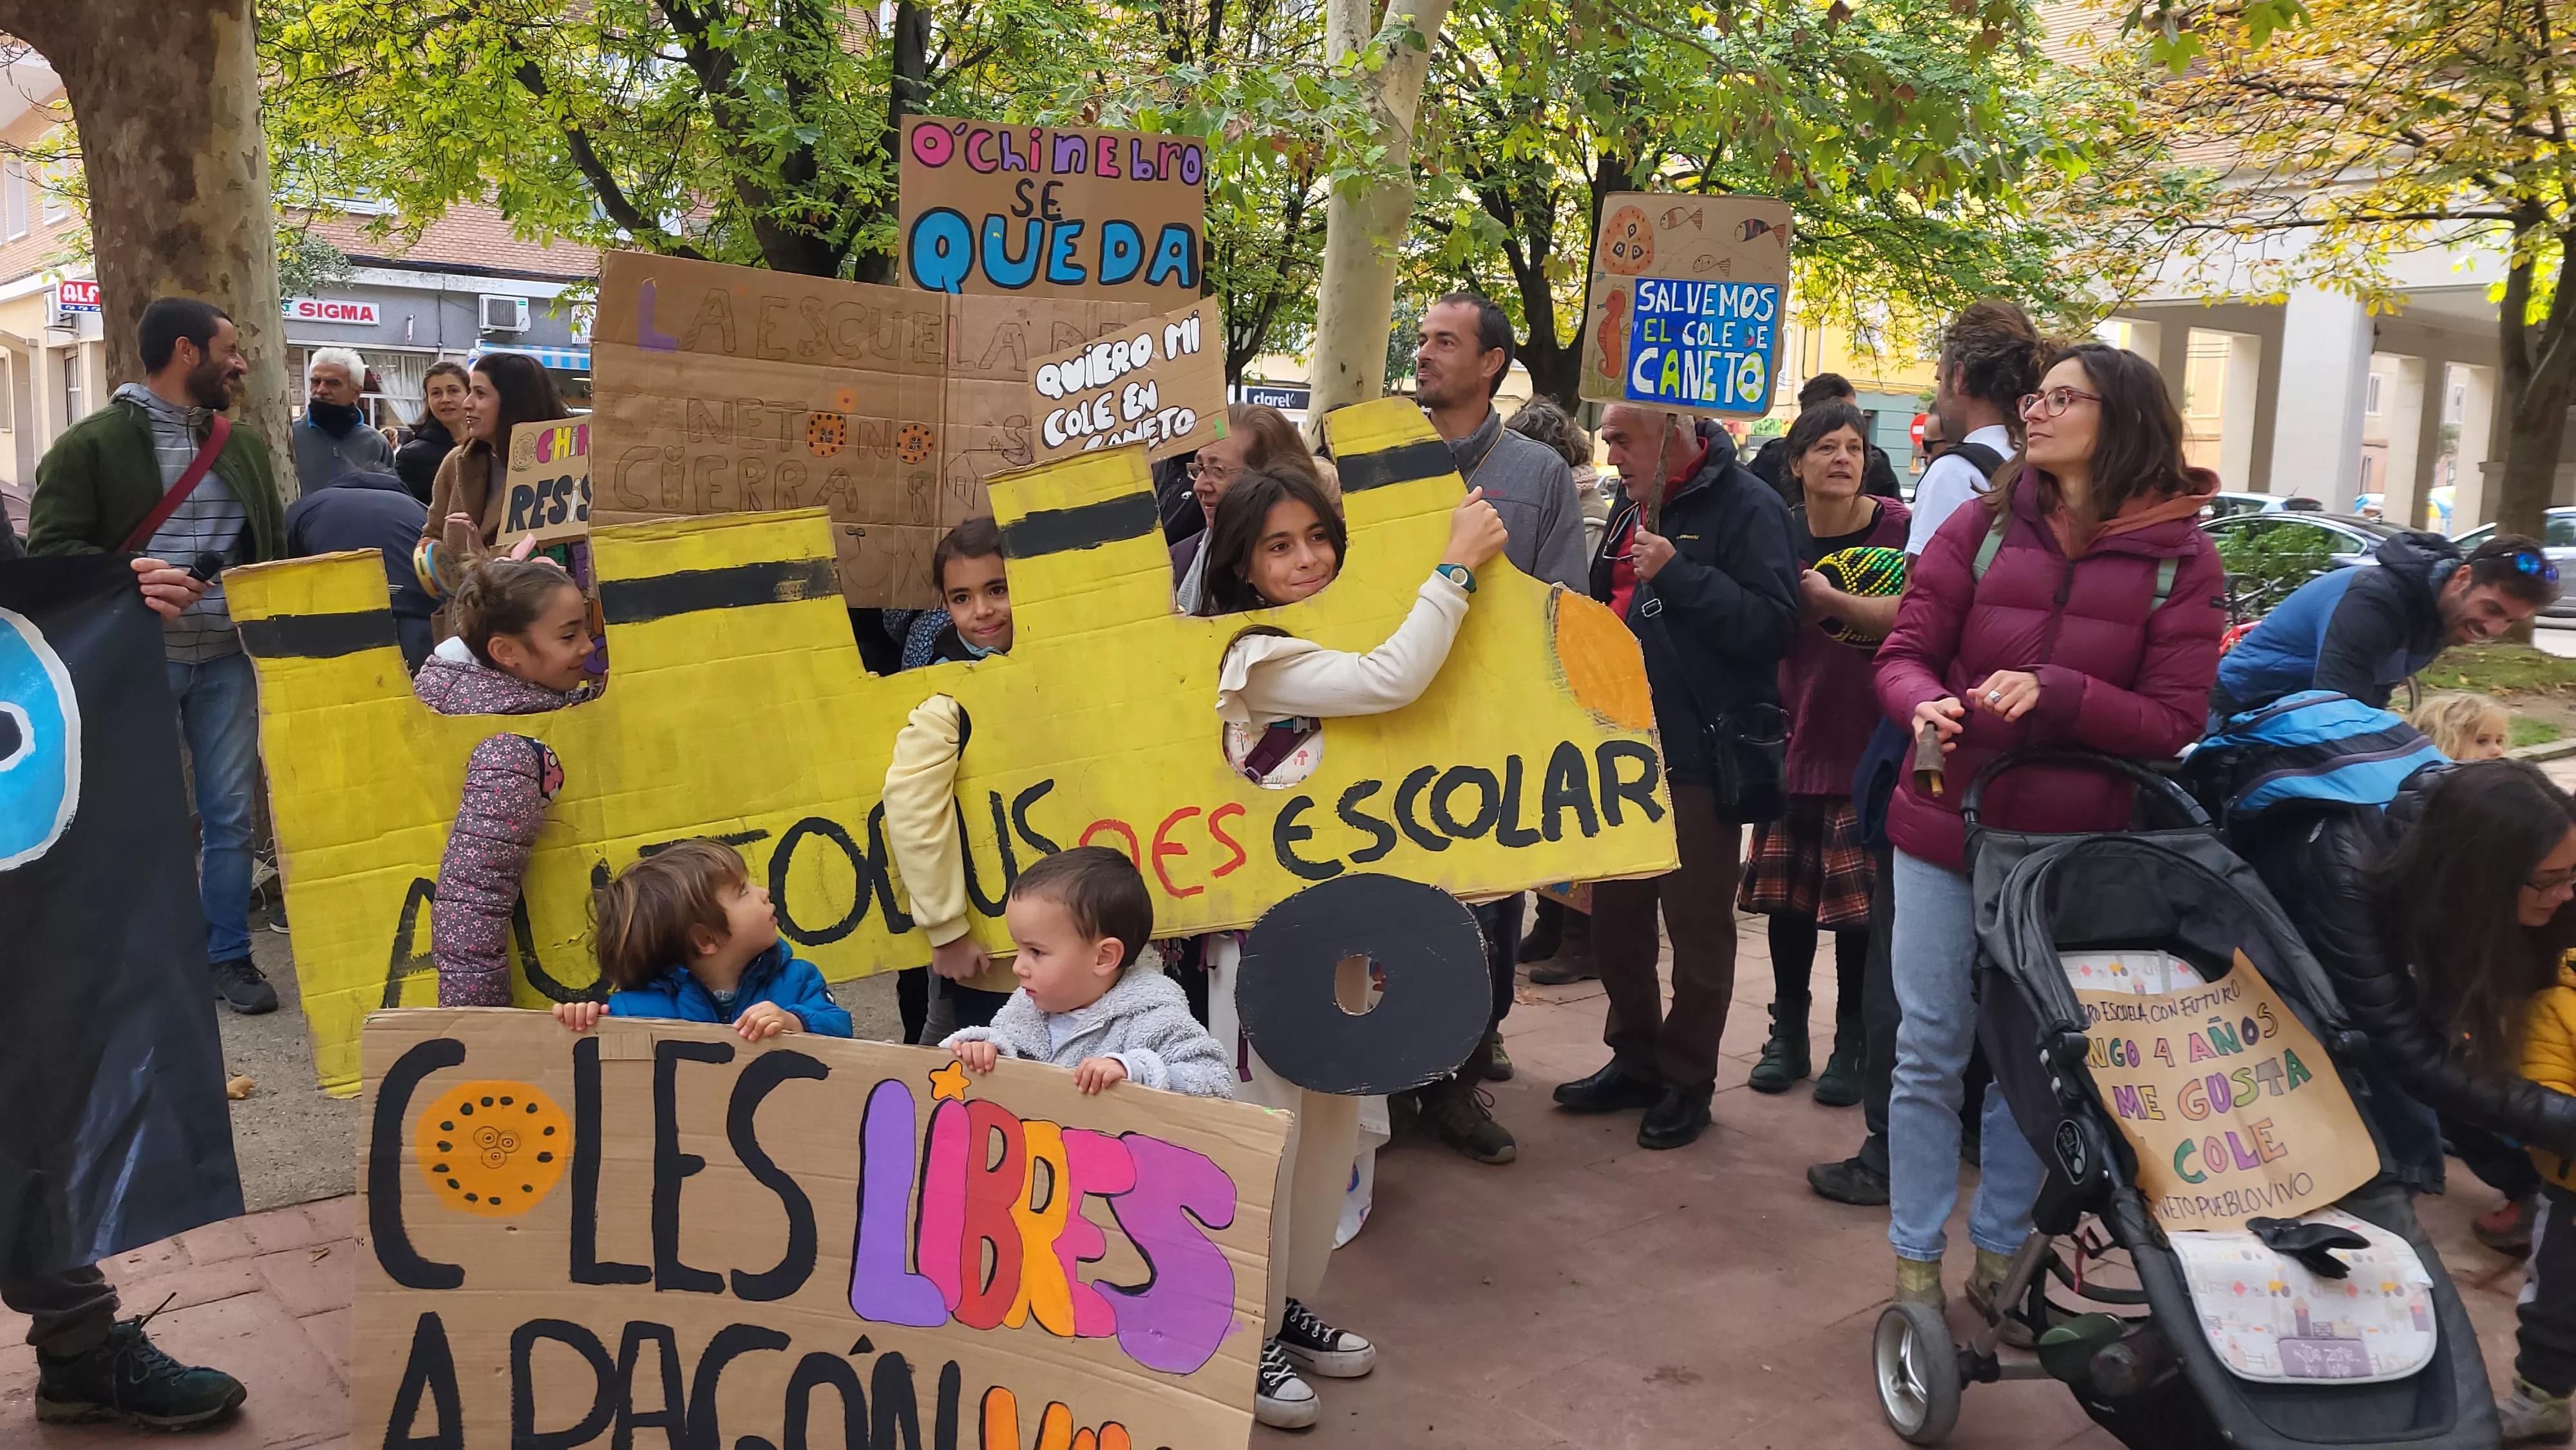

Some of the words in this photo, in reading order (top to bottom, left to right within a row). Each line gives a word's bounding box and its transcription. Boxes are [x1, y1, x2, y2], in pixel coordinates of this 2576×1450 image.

[1011, 178, 1064, 221] SE
[907, 207, 1200, 294] QUEDA
[299, 302, 374, 321] SIGMA
[636, 277, 737, 353] LA
[757, 296, 1028, 372] ESCUELA
[1637, 281, 1776, 321] SALVEMOS
[1644, 318, 1672, 343] EL
[1682, 321, 1736, 347] COLE
[1743, 323, 1768, 349] DE
[1253, 392, 1290, 408] clarel
[1632, 346, 1765, 403] CANETO
[1042, 390, 1116, 449] COLE
[1120, 379, 1159, 423] EN
[858, 420, 934, 464] NO
[1273, 740, 1665, 880] ESCOLAR
[2099, 1001, 2150, 1024] ESCUELA
[2150, 998, 2179, 1022] CON
[2181, 979, 2241, 1017] FUTURO
[2085, 1037, 2140, 1069] NGO
[2154, 1037, 2176, 1068] 4
[2189, 1002, 2278, 1062] AÑOS
[2112, 1085, 2166, 1121] ME
[2177, 1048, 2313, 1122] GUSTA
[2174, 1118, 2287, 1185] COLE
[2154, 1195, 2196, 1219] NETO
[2195, 1188, 2261, 1219] PUEBLO
